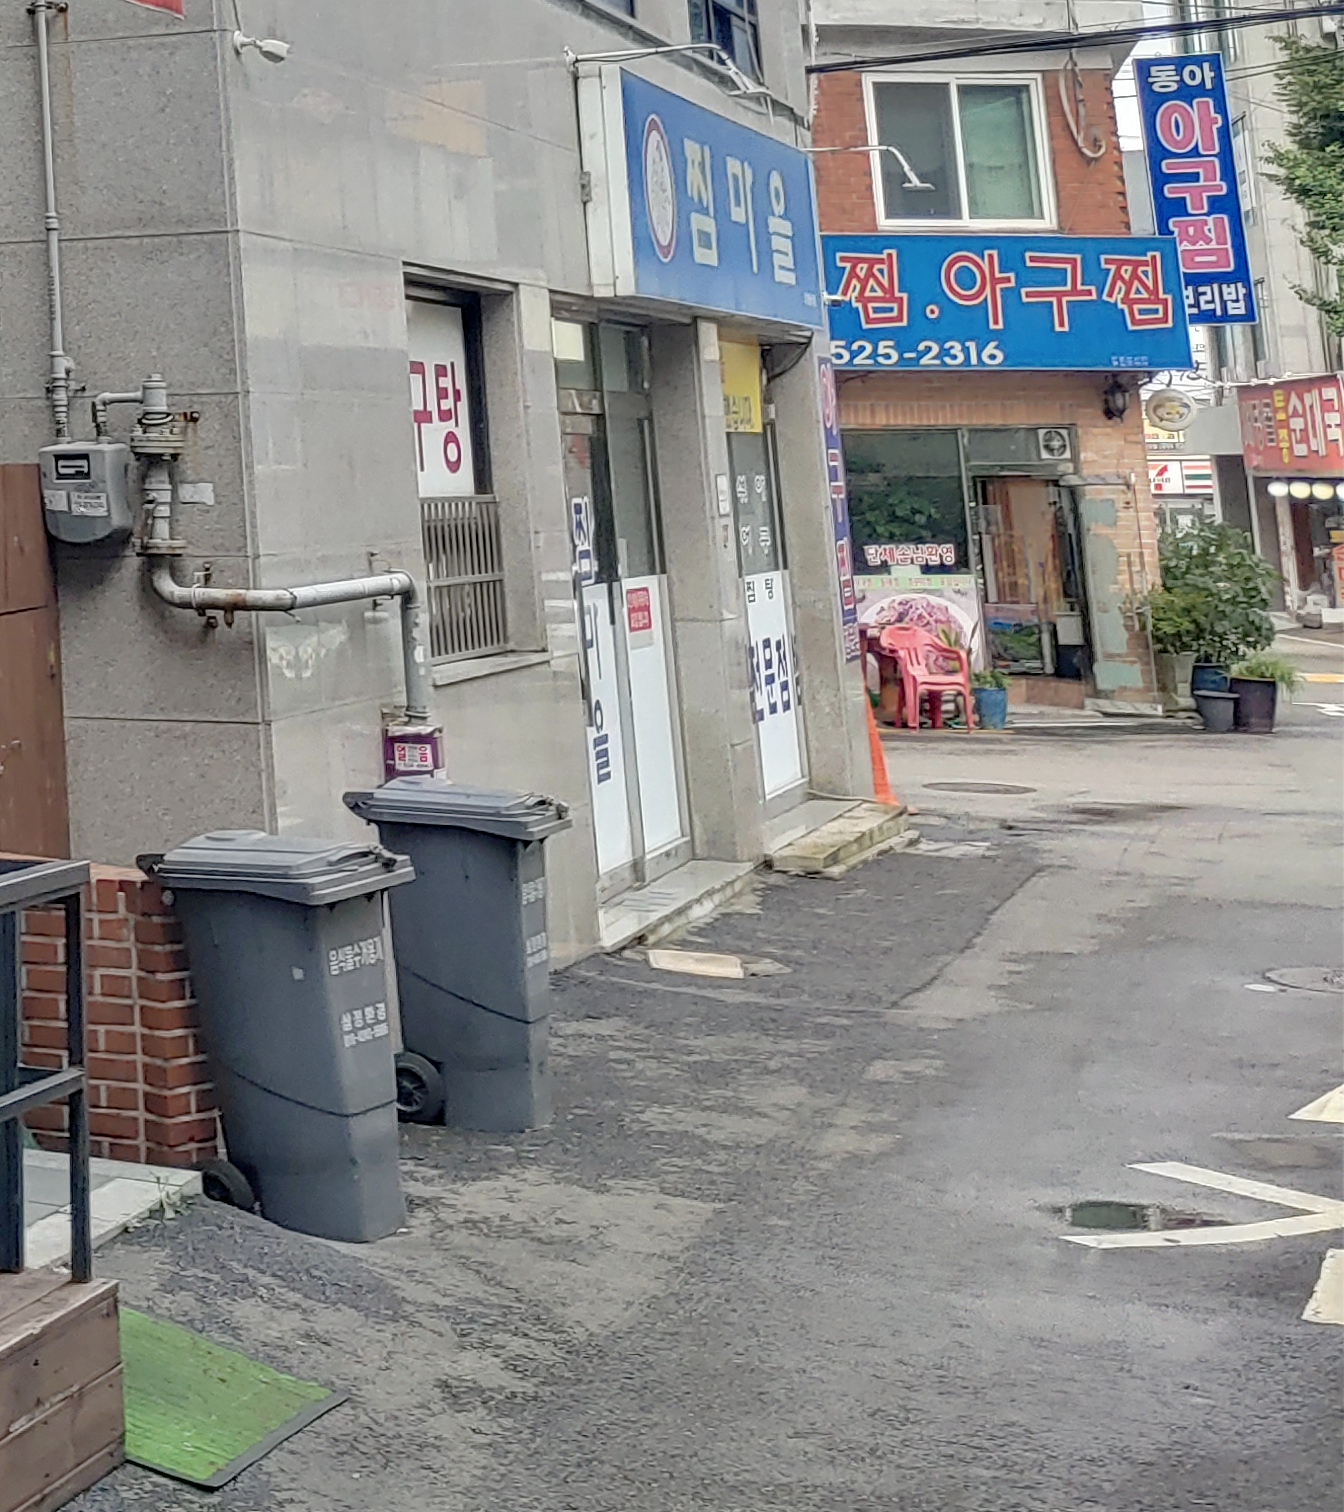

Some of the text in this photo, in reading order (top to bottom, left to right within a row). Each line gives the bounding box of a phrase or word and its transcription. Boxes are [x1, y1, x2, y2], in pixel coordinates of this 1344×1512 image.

[1147, 62, 1216, 93] 동아
[829, 339, 1005, 367] 525-2316
[1288, 386, 1344, 457] 순대국
